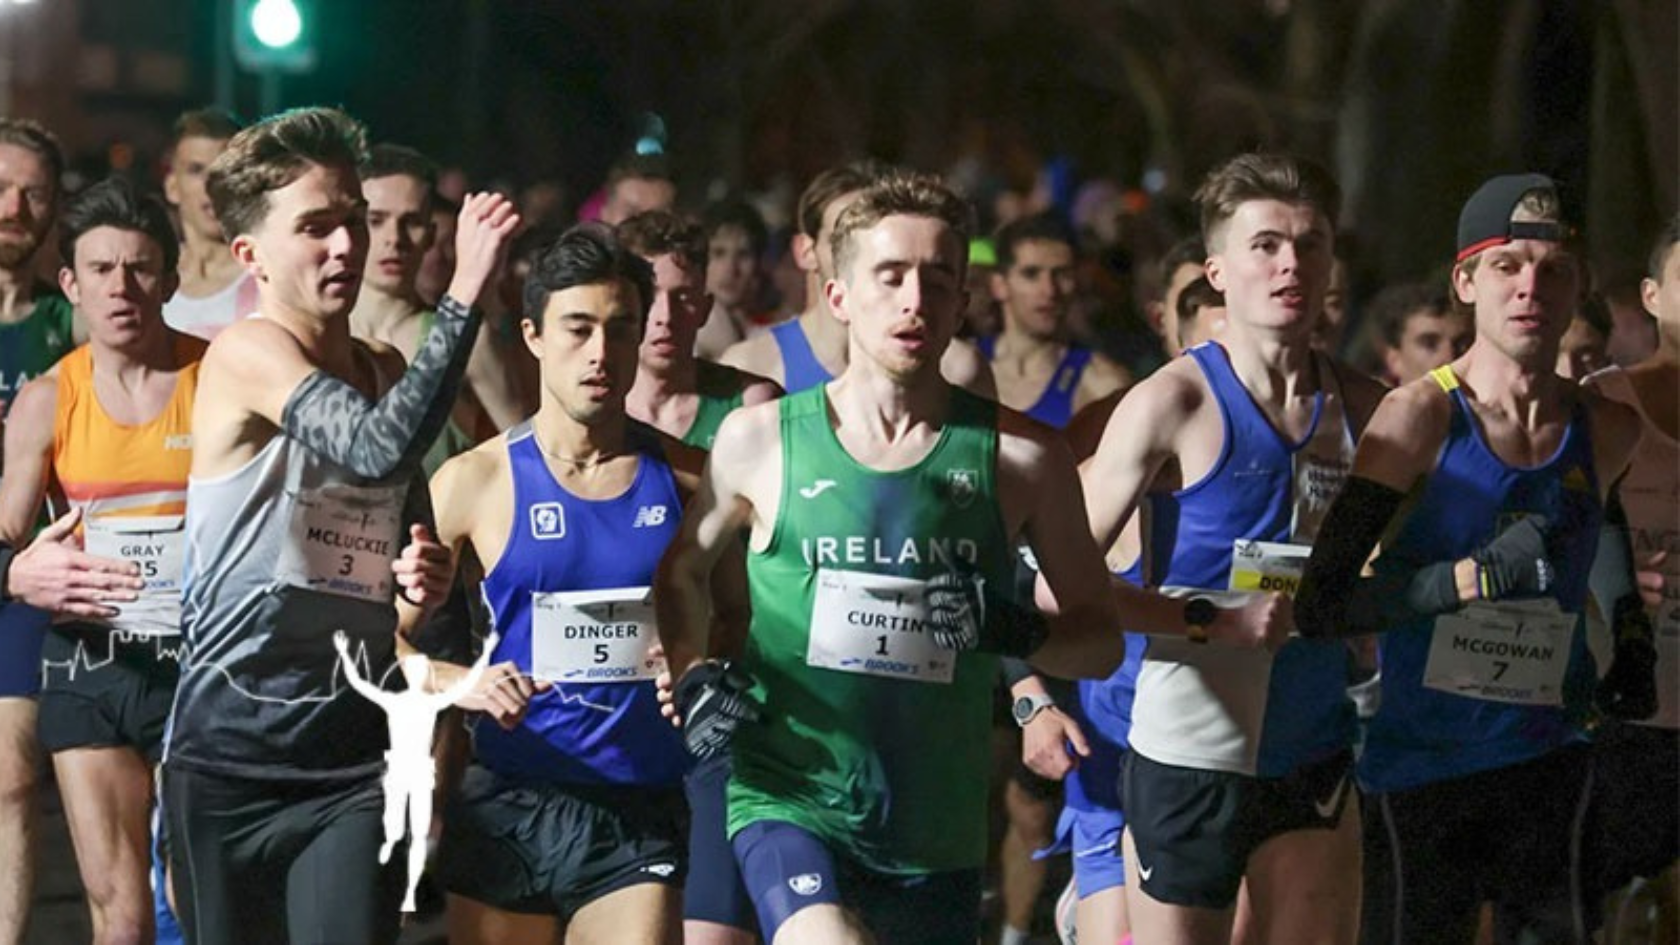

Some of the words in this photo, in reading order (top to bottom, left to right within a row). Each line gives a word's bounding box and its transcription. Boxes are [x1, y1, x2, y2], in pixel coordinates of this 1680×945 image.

[120, 545, 165, 557] GRAY
[306, 527, 390, 555] MCLUCKIE
[801, 537, 978, 566] IRELAND
[338, 554, 354, 576] 3
[564, 625, 638, 639] DINGER
[847, 610, 925, 633] CURTIN
[593, 643, 610, 664] 5
[875, 634, 889, 656] 1
[1452, 635, 1555, 661] MCGOWAN
[586, 667, 637, 678] BROOKS
[864, 658, 920, 675] BROOKS
[1492, 661, 1509, 681] 7
